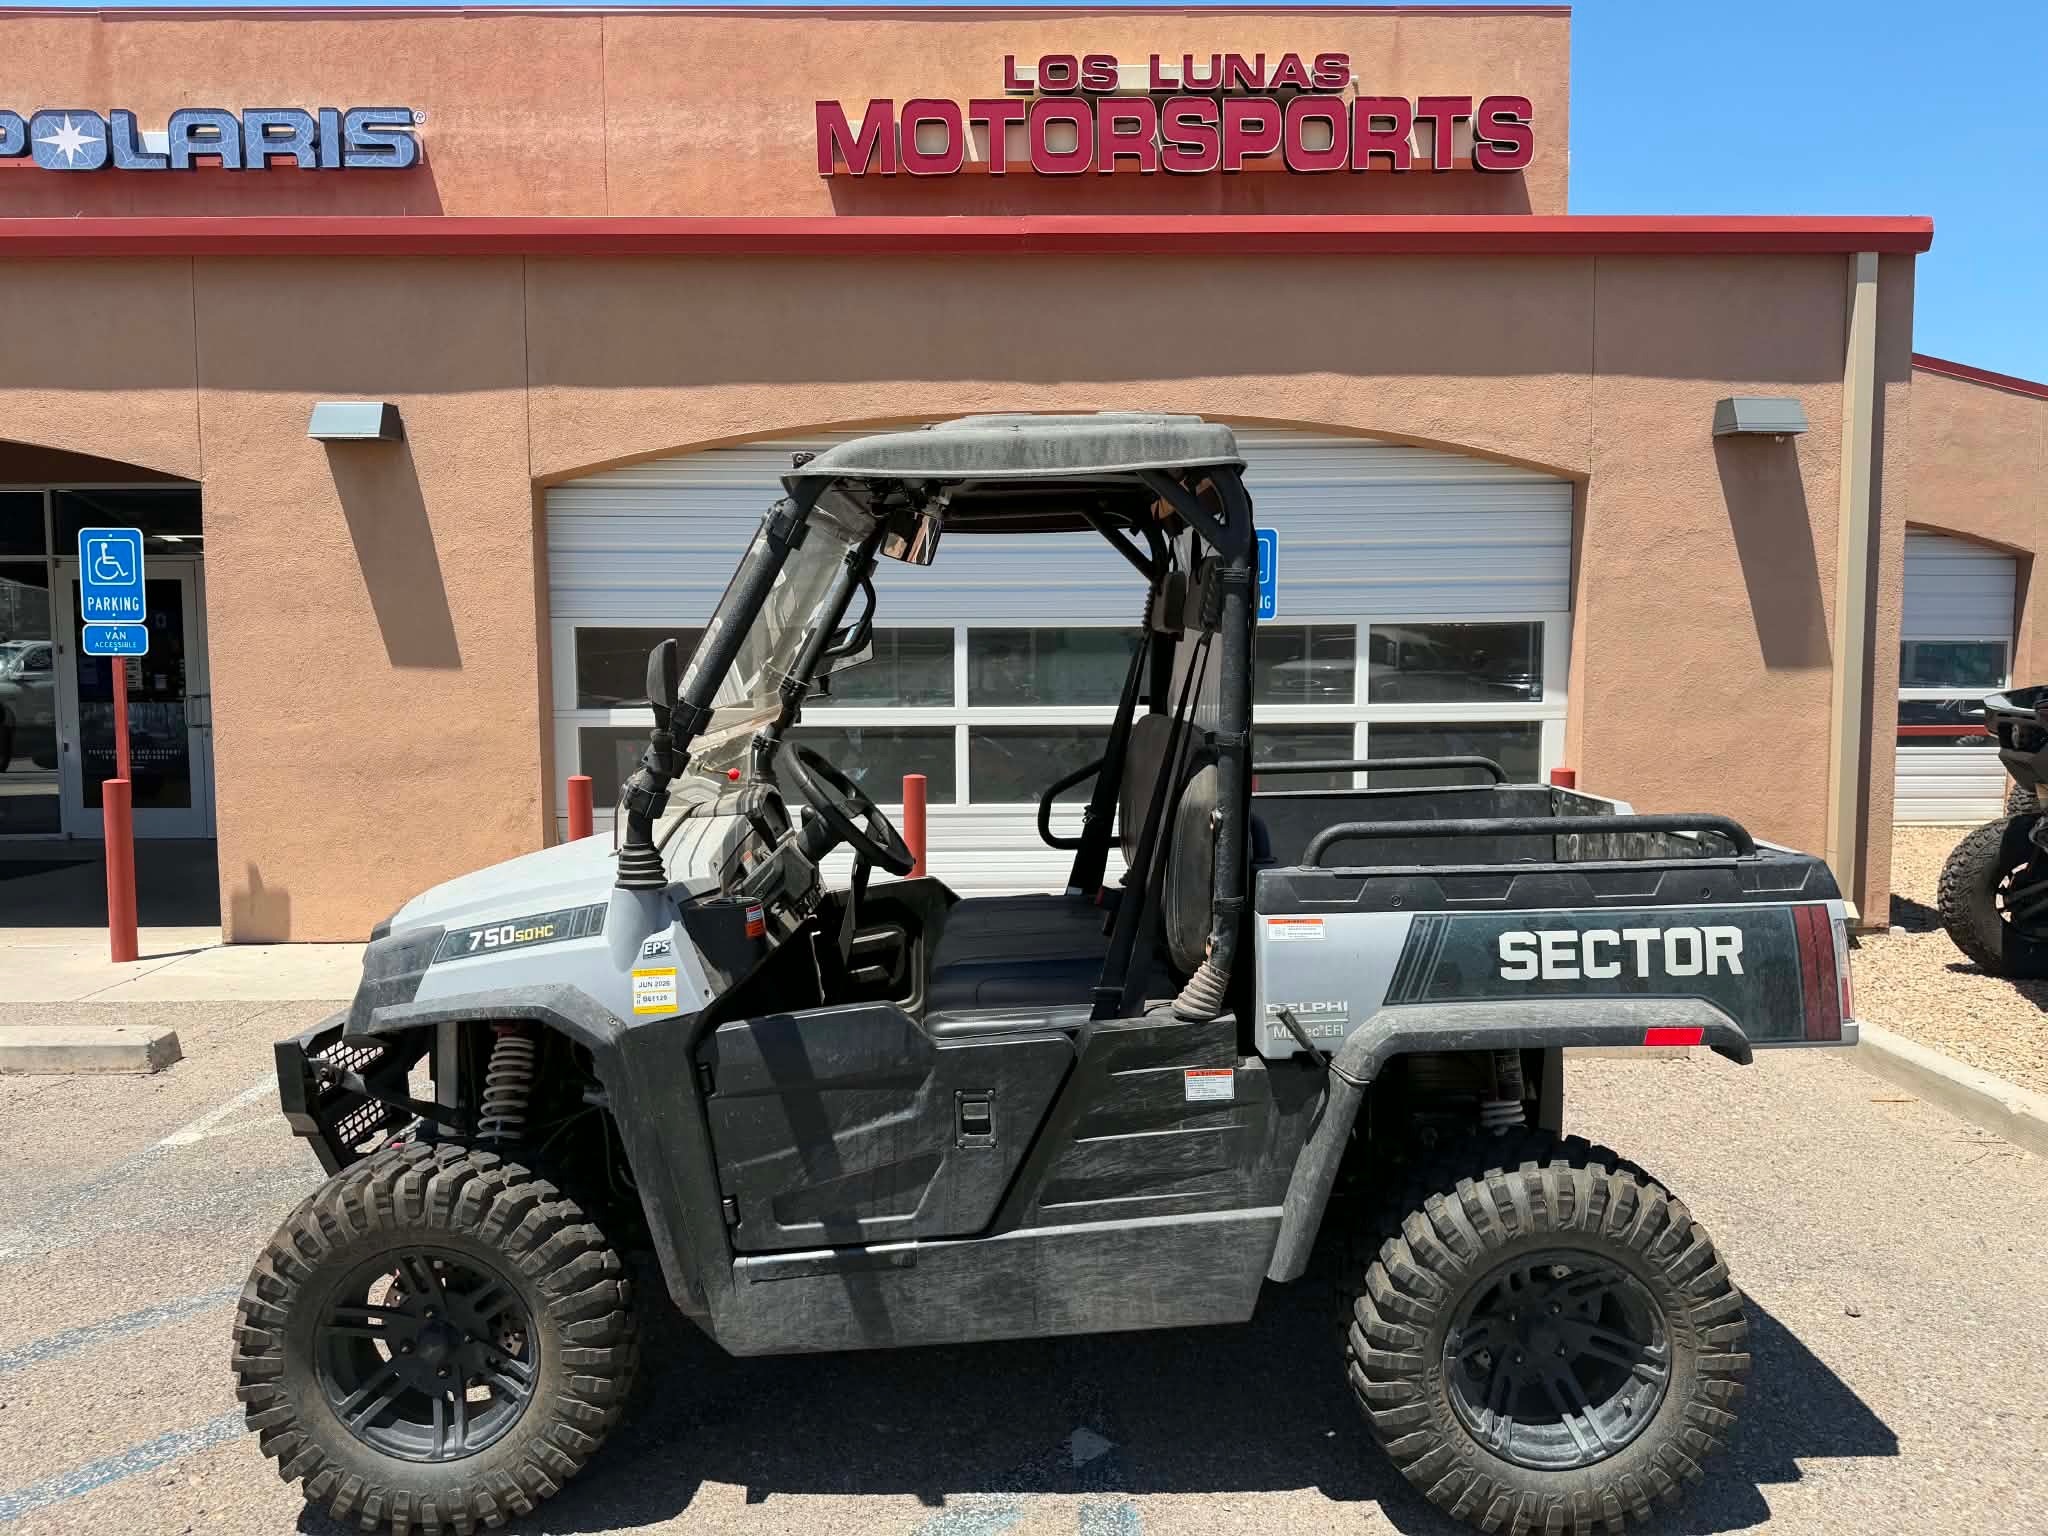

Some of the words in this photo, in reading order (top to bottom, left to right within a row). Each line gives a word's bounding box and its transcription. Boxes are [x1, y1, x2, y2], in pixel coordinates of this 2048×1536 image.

[1003, 53, 1120, 91] LOS
[1149, 53, 1351, 90] LUNAS
[815, 95, 1535, 175] MOTORSPORTS
[87, 597, 140, 611] PARKING
[105, 631, 127, 640] VAN
[95, 641, 137, 649] ACCESSIBLE
[644, 940, 670, 955] EPS
[1499, 926, 1745, 981] SECTOR
[639, 980, 653, 988] JUN
[1265, 1000, 1348, 1014] DELPHI
[1273, 1023, 1320, 1039] Mec
